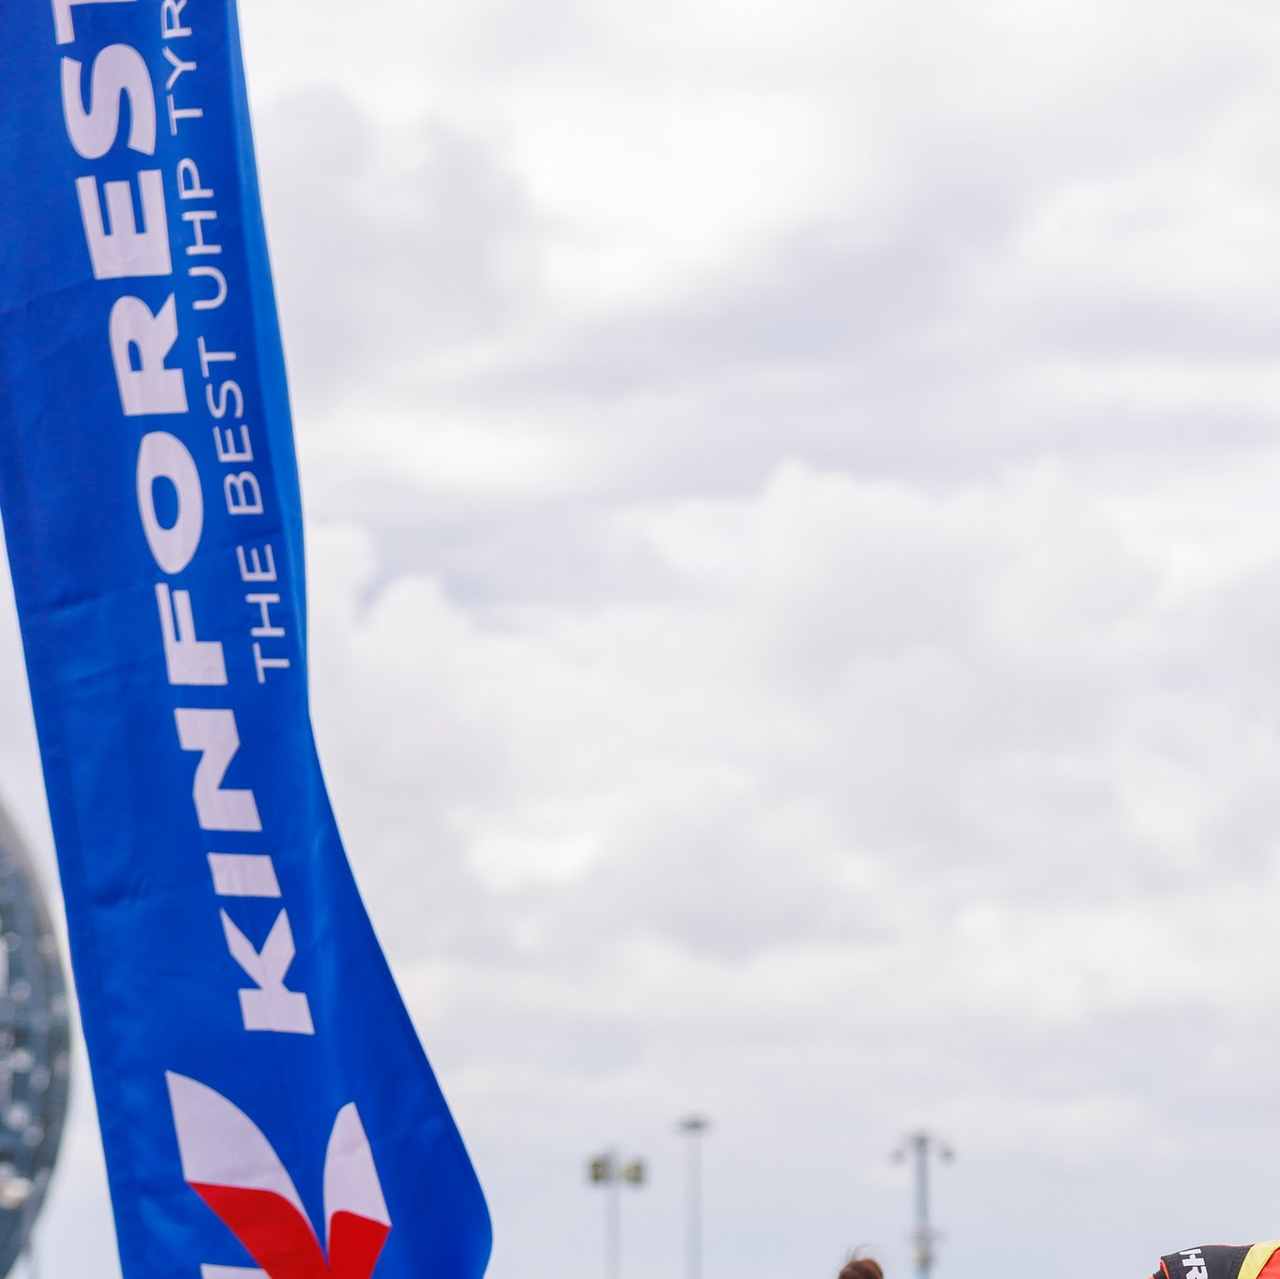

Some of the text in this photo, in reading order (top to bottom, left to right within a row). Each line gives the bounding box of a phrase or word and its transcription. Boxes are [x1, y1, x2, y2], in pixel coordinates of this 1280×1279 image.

[177, 157, 228, 310] UHP
[197, 336, 264, 515] BEST
[236, 544, 290, 684] THE
